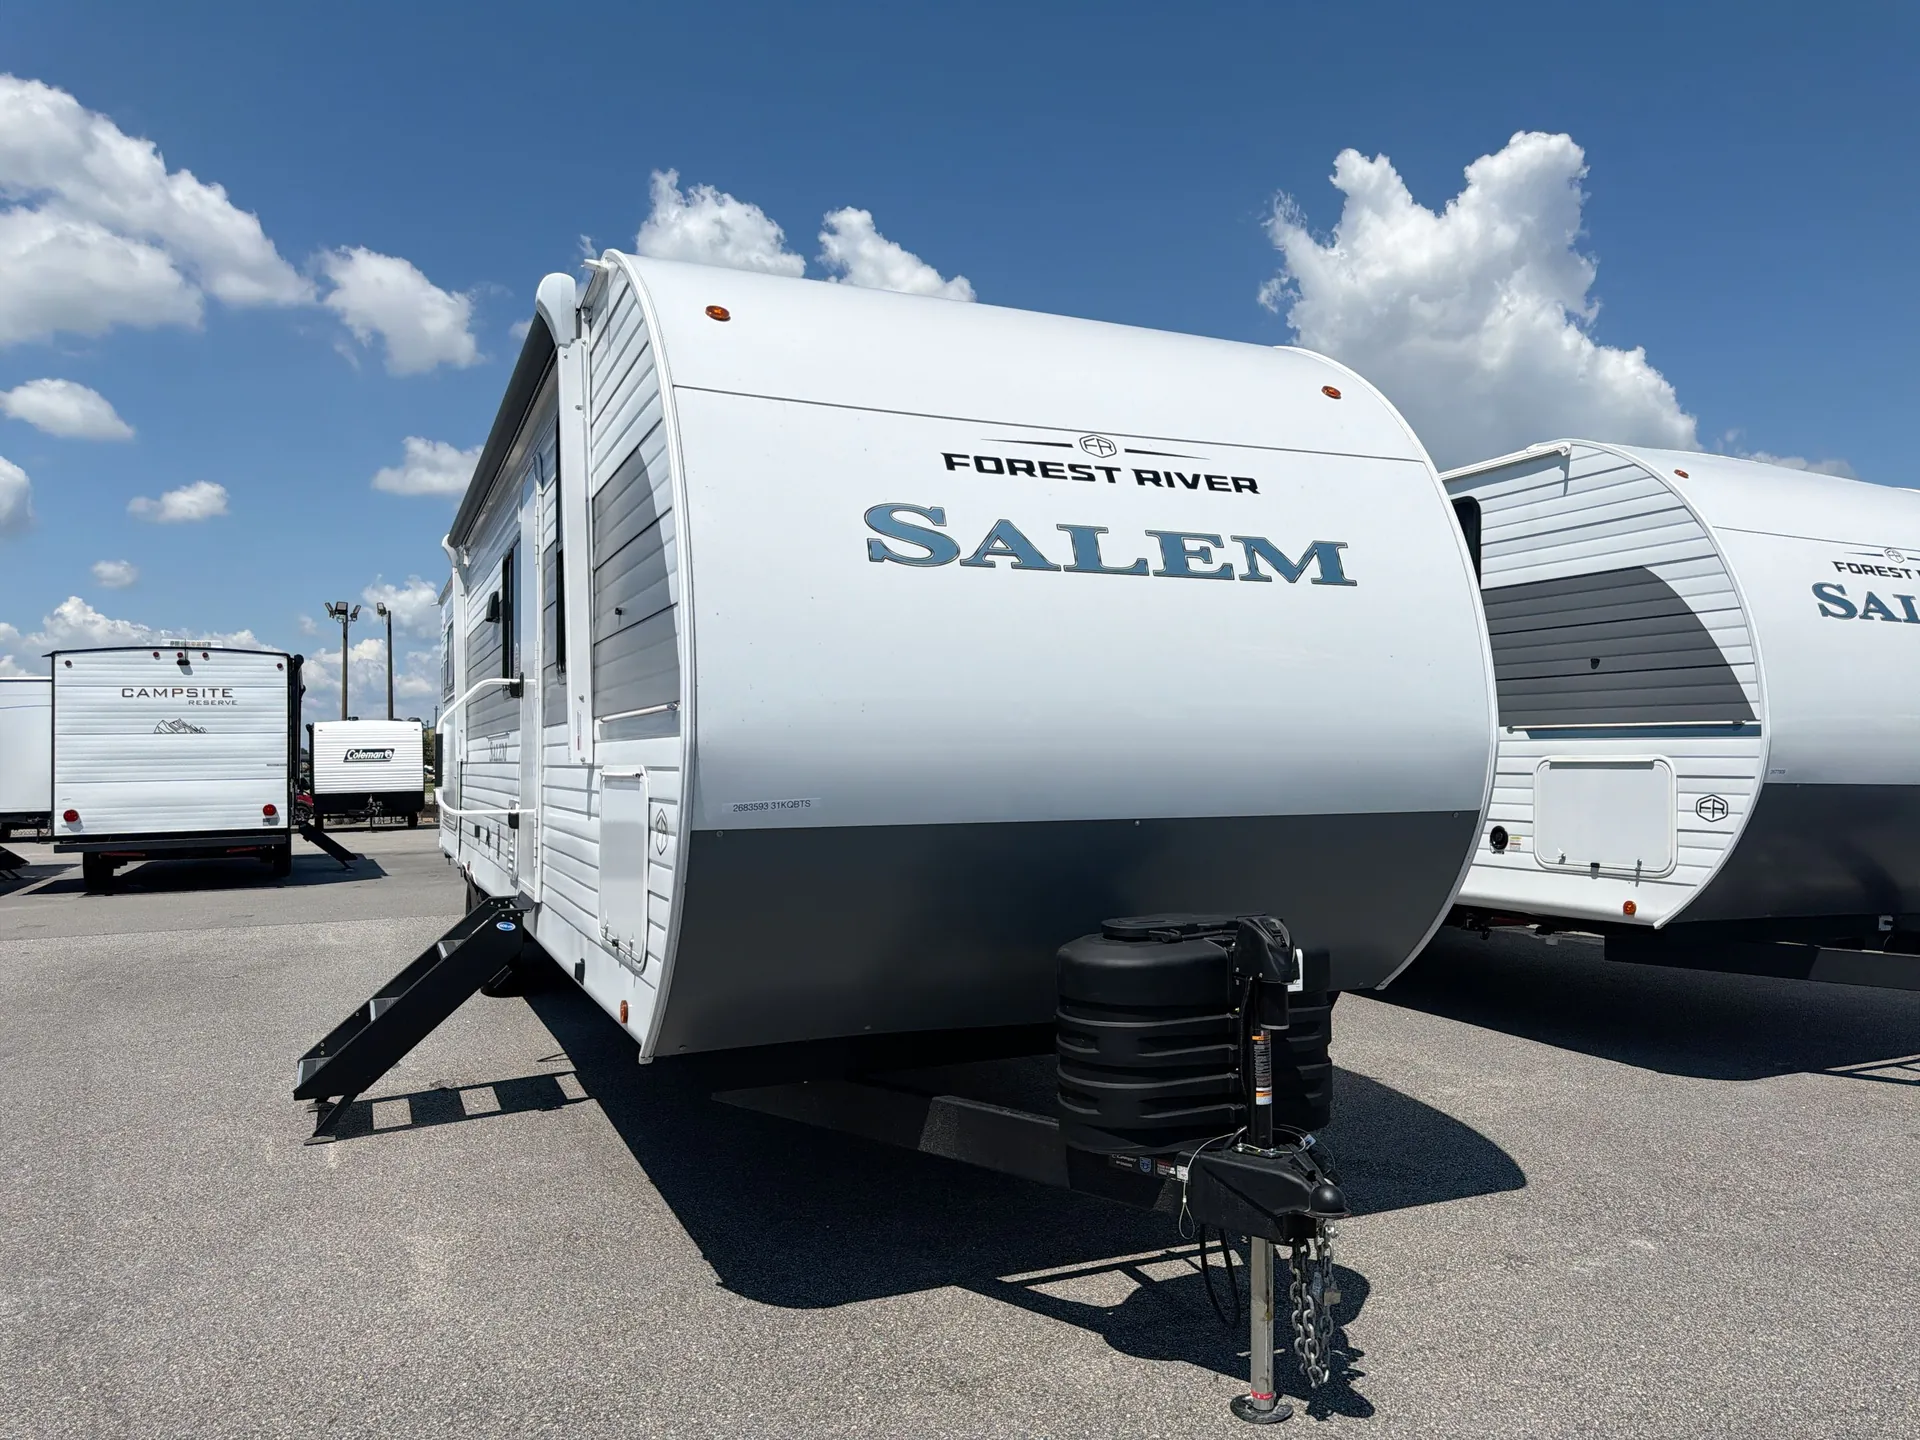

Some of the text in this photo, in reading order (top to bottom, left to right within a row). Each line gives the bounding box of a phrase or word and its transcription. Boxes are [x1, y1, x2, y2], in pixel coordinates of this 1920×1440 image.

[941, 452, 1261, 495] FOREST RIVER
[864, 502, 1357, 587] SALEM
[1831, 560, 1913, 580] FOREST
[121, 687, 234, 699] CAMPSITE
[347, 749, 385, 760] Coleman
[732, 799, 811, 812] 2683593 31KQBTS
